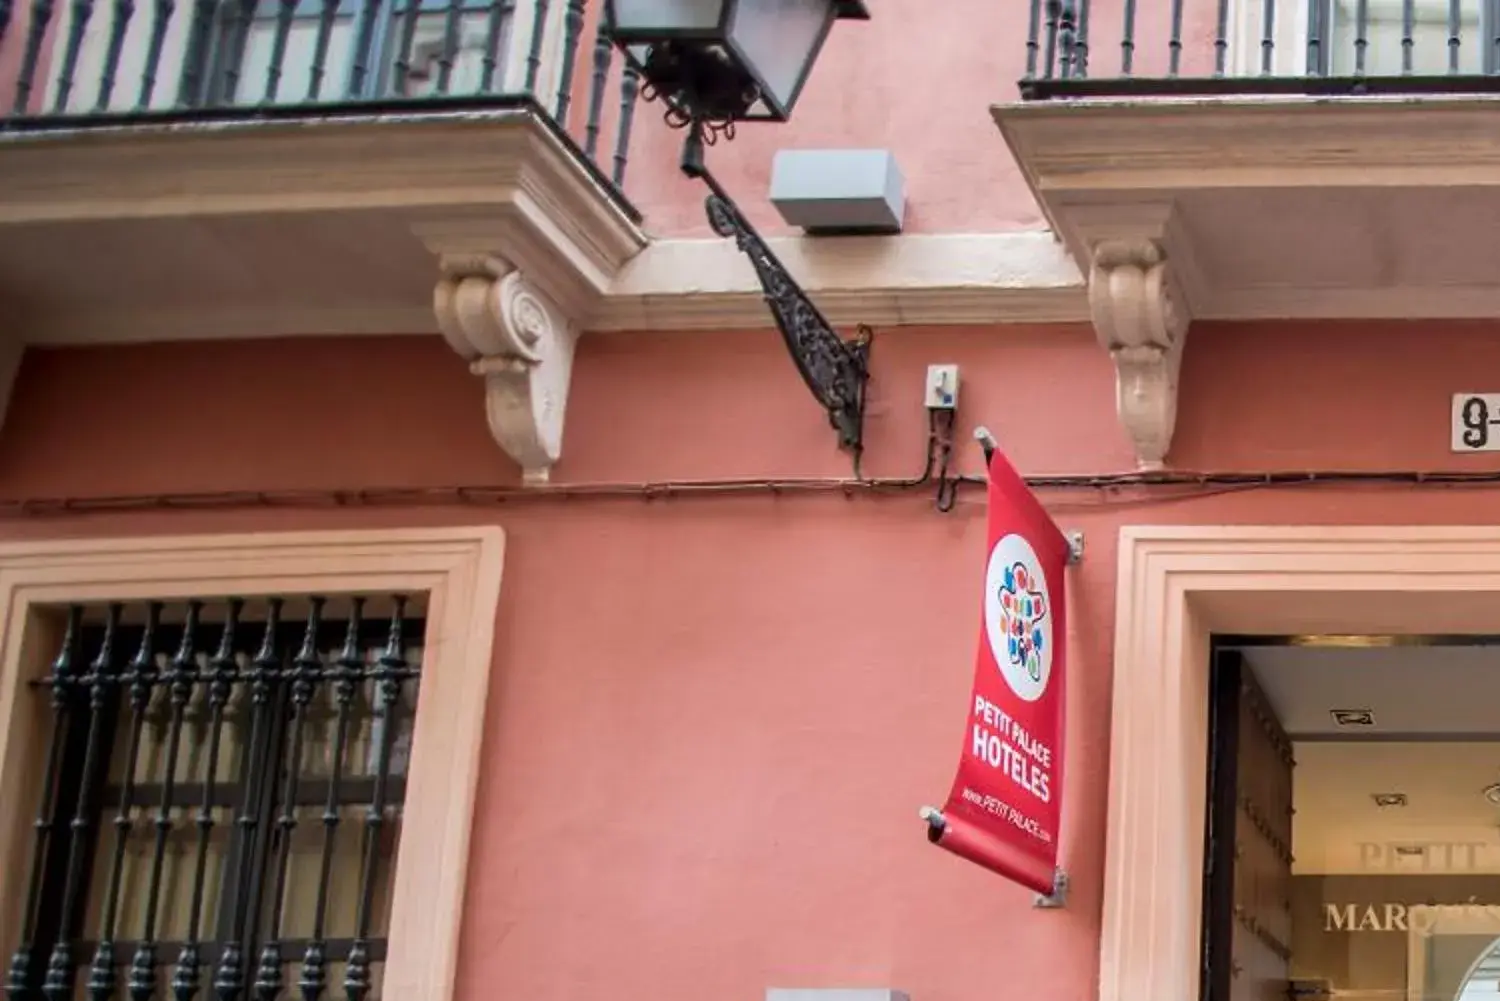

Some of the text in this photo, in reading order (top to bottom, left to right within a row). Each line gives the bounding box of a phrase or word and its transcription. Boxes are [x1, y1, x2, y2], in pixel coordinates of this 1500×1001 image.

[972, 723, 1050, 803] HOTELES
[975, 694, 1051, 768] PETIT PALACE
[1356, 841, 1486, 871] PETIT
